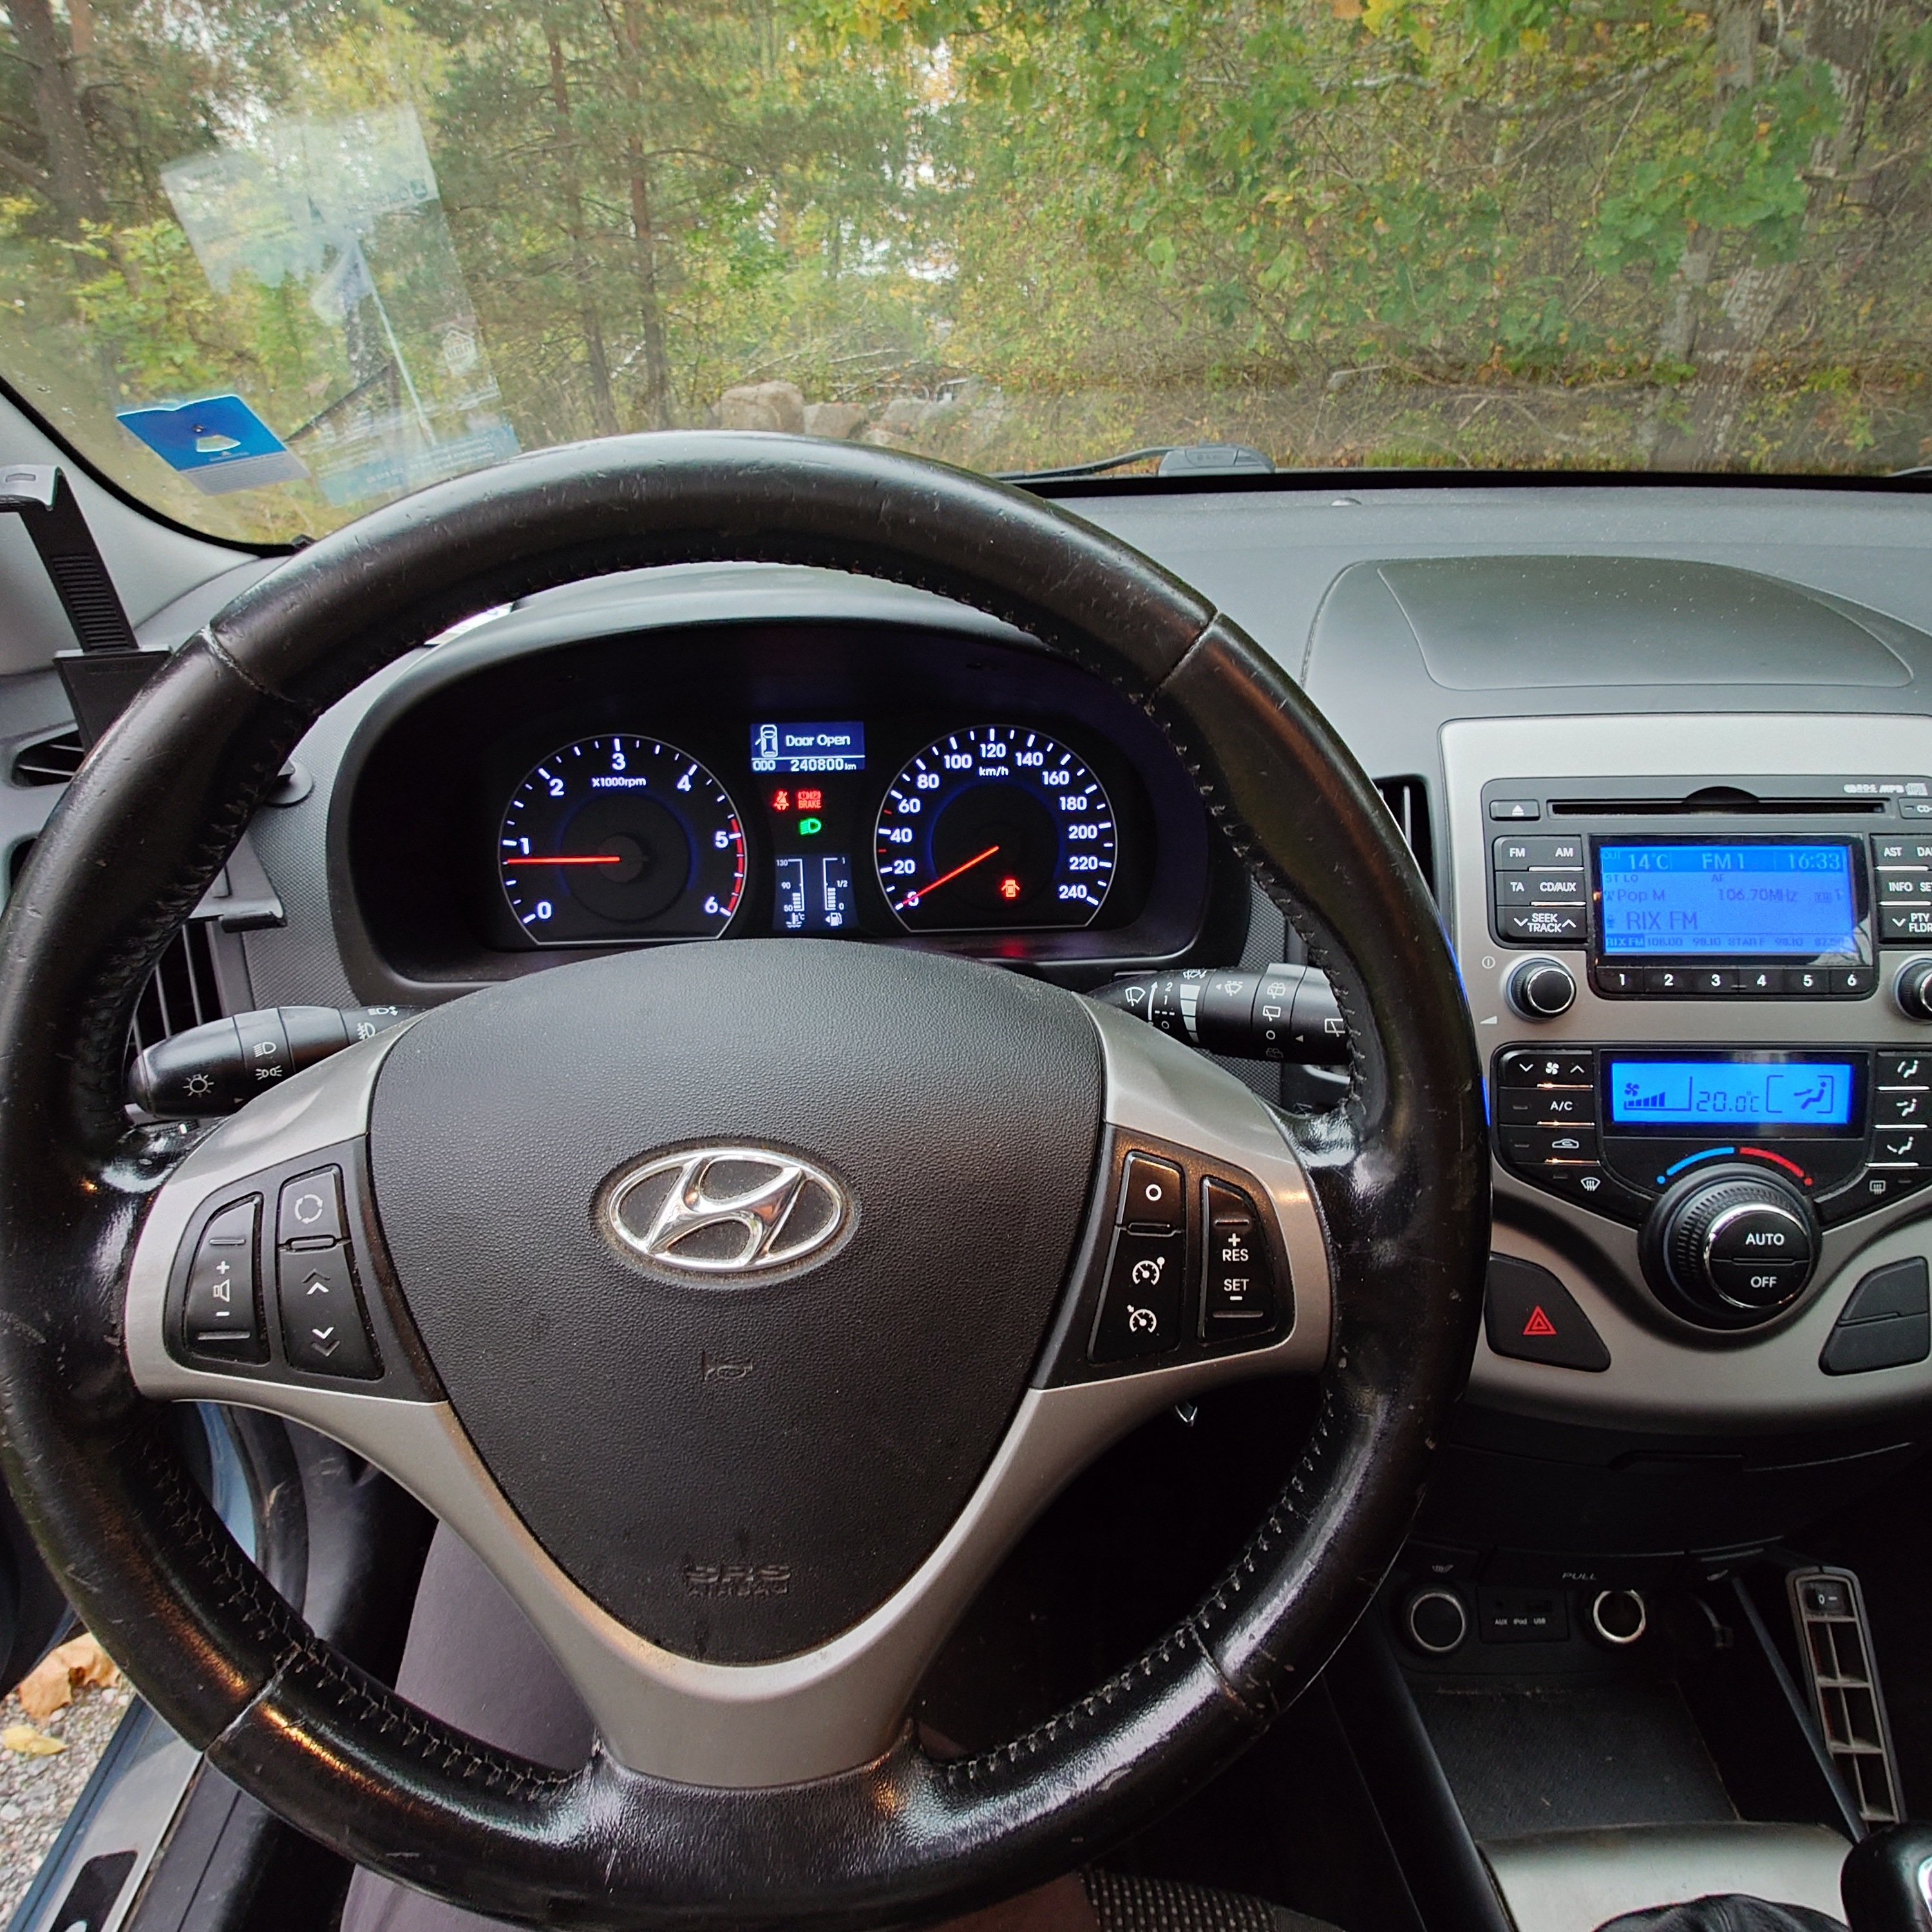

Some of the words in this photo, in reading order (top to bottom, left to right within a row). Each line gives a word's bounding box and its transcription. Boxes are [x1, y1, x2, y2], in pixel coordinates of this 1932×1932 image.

[786, 735, 815, 746] Door
[817, 734, 851, 747] Open
[980, 743, 1006, 758] 120
[612, 753, 625, 770] 3
[790, 758, 844, 772] 240800
[944, 754, 972, 769] 100
[1016, 752, 1043, 766] 140
[979, 766, 1009, 777] km/h
[1043, 771, 1070, 785] 160
[550, 779, 564, 796] 2
[677, 775, 691, 791] 4
[917, 774, 940, 789] 80
[799, 800, 822, 809] BRAKE
[899, 799, 921, 813] 60
[1059, 796, 1087, 811] 180
[890, 828, 913, 843] 40
[1069, 825, 1097, 839] 200
[715, 831, 728, 848] 5
[520, 838, 529, 855] 1
[1510, 848, 1526, 857] FM
[1555, 848, 1573, 857] AM
[1884, 847, 1902, 857] AST
[1917, 847, 1932, 857] DA
[894, 860, 915, 874] 20
[1069, 857, 1098, 870] 220
[1789, 853, 1840, 869] 16:33
[837, 880, 848, 888] 1/2
[1510, 882, 1524, 892] TA
[1540, 882, 1577, 893] CD/AUX
[1888, 882, 1913, 892] INFO
[1920, 882, 1932, 892] SE
[1059, 885, 1087, 899] 240
[1617, 889, 1647, 903] Pop
[1653, 889, 1665, 900] M
[537, 902, 552, 919] 0
[705, 896, 718, 913] 6
[1531, 913, 1558, 923] SEEK
[1626, 911, 1662, 930] RIX
[1670, 911, 1698, 930] FM
[1910, 913, 1930, 922] PTY
[1527, 922, 1562, 933] TRACK
[1607, 938, 1626, 946] RIX
[1629, 938, 1643, 946] FM
[1619, 974, 1625, 986] 1
[1664, 974, 1674, 986] 2
[1710, 974, 1721, 987] 3
[1756, 974, 1766, 986] 4
[1803, 974, 1813, 987] 5
[1848, 974, 1857, 986] 6
[1166, 982, 1173, 992] 2
[1164, 996, 1168, 1006] 1
[1550, 1101, 1573, 1112] A/C
[1745, 1233, 1785, 1246] AUTO
[1223, 1249, 1248, 1262] RES
[1224, 1278, 1249, 1291] SET
[1750, 1276, 1777, 1289] OFF
[1562, 1572, 1596, 1580] PULL
